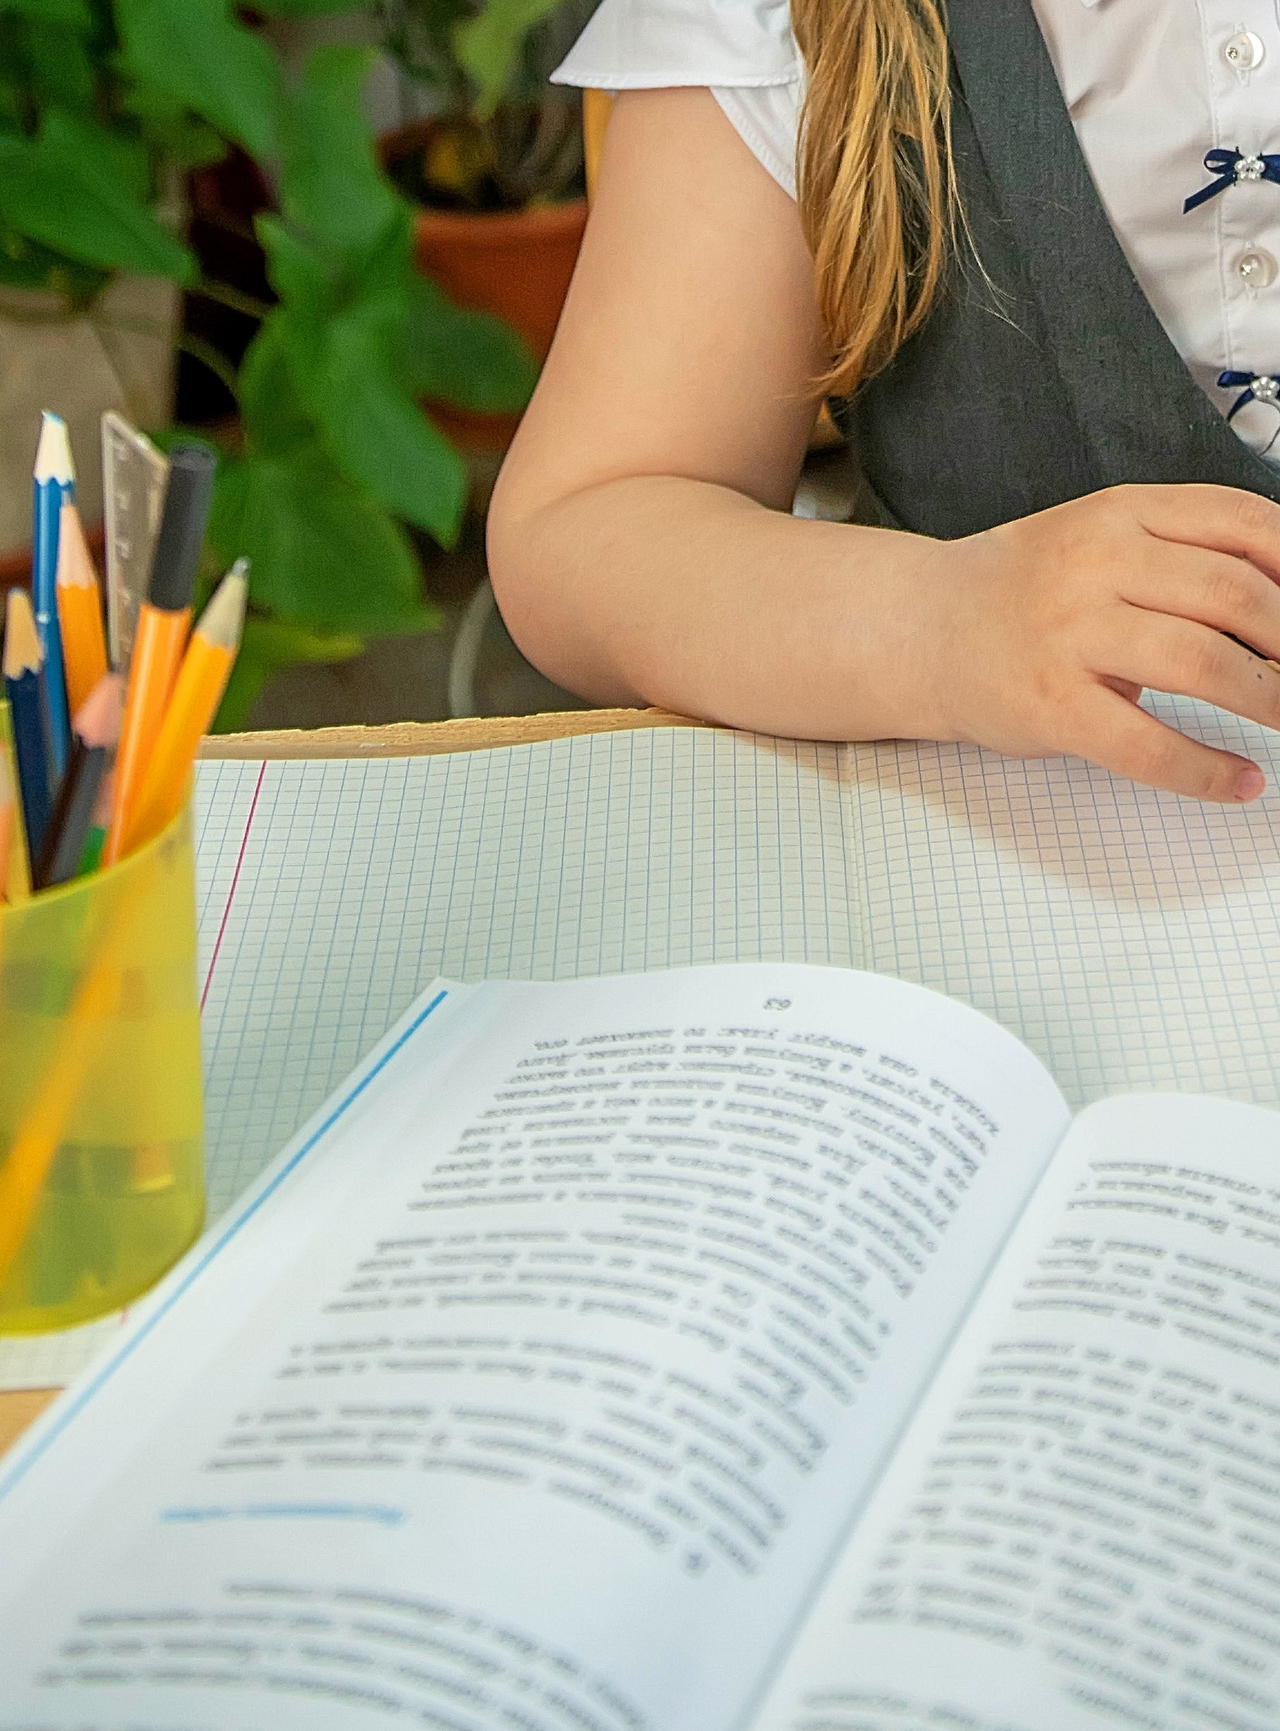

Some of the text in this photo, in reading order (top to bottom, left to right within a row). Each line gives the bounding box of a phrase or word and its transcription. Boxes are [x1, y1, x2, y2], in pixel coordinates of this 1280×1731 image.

[761, 996, 792, 1011] 63
[682, 1045, 736, 1059] была
[788, 1030, 868, 1058] вокруг
[516, 1054, 574, 1069] Долго
[742, 1045, 832, 1071] Копуша
[877, 1052, 921, 1079] она
[574, 1065, 606, 1078] что
[734, 1083, 826, 1115] Копуша
